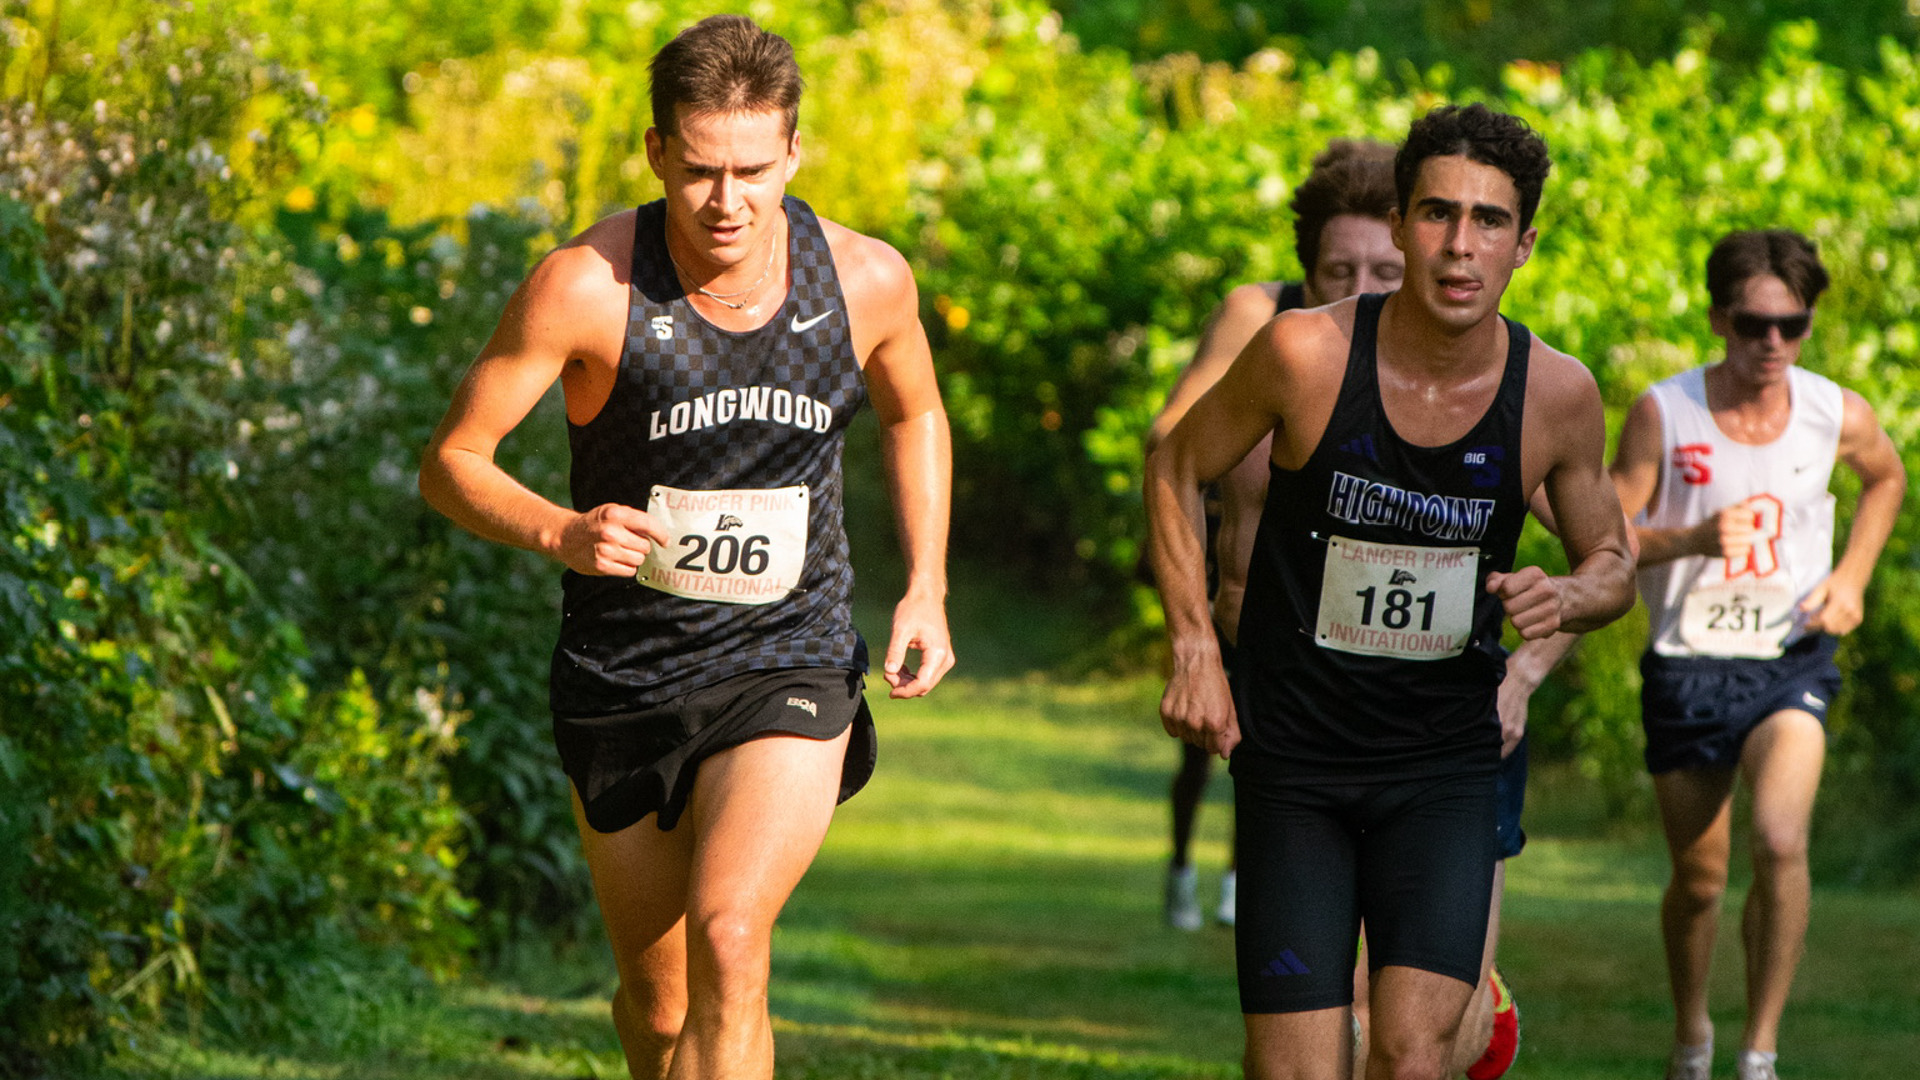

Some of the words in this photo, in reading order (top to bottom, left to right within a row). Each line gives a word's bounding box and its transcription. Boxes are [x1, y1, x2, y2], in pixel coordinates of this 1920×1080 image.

[649, 386, 832, 441] LONGWOOD
[1464, 453, 1486, 464] BIG
[665, 492, 742, 512] LANCER
[750, 494, 795, 511] PINK
[674, 534, 770, 575] 206
[1341, 542, 1418, 567] LANCER
[1423, 551, 1466, 569] PINK
[651, 567, 784, 596] INVITATIONAL
[1356, 586, 1436, 631] 181
[1707, 604, 1763, 632] 231
[1329, 622, 1455, 651] INVITATIONAL
